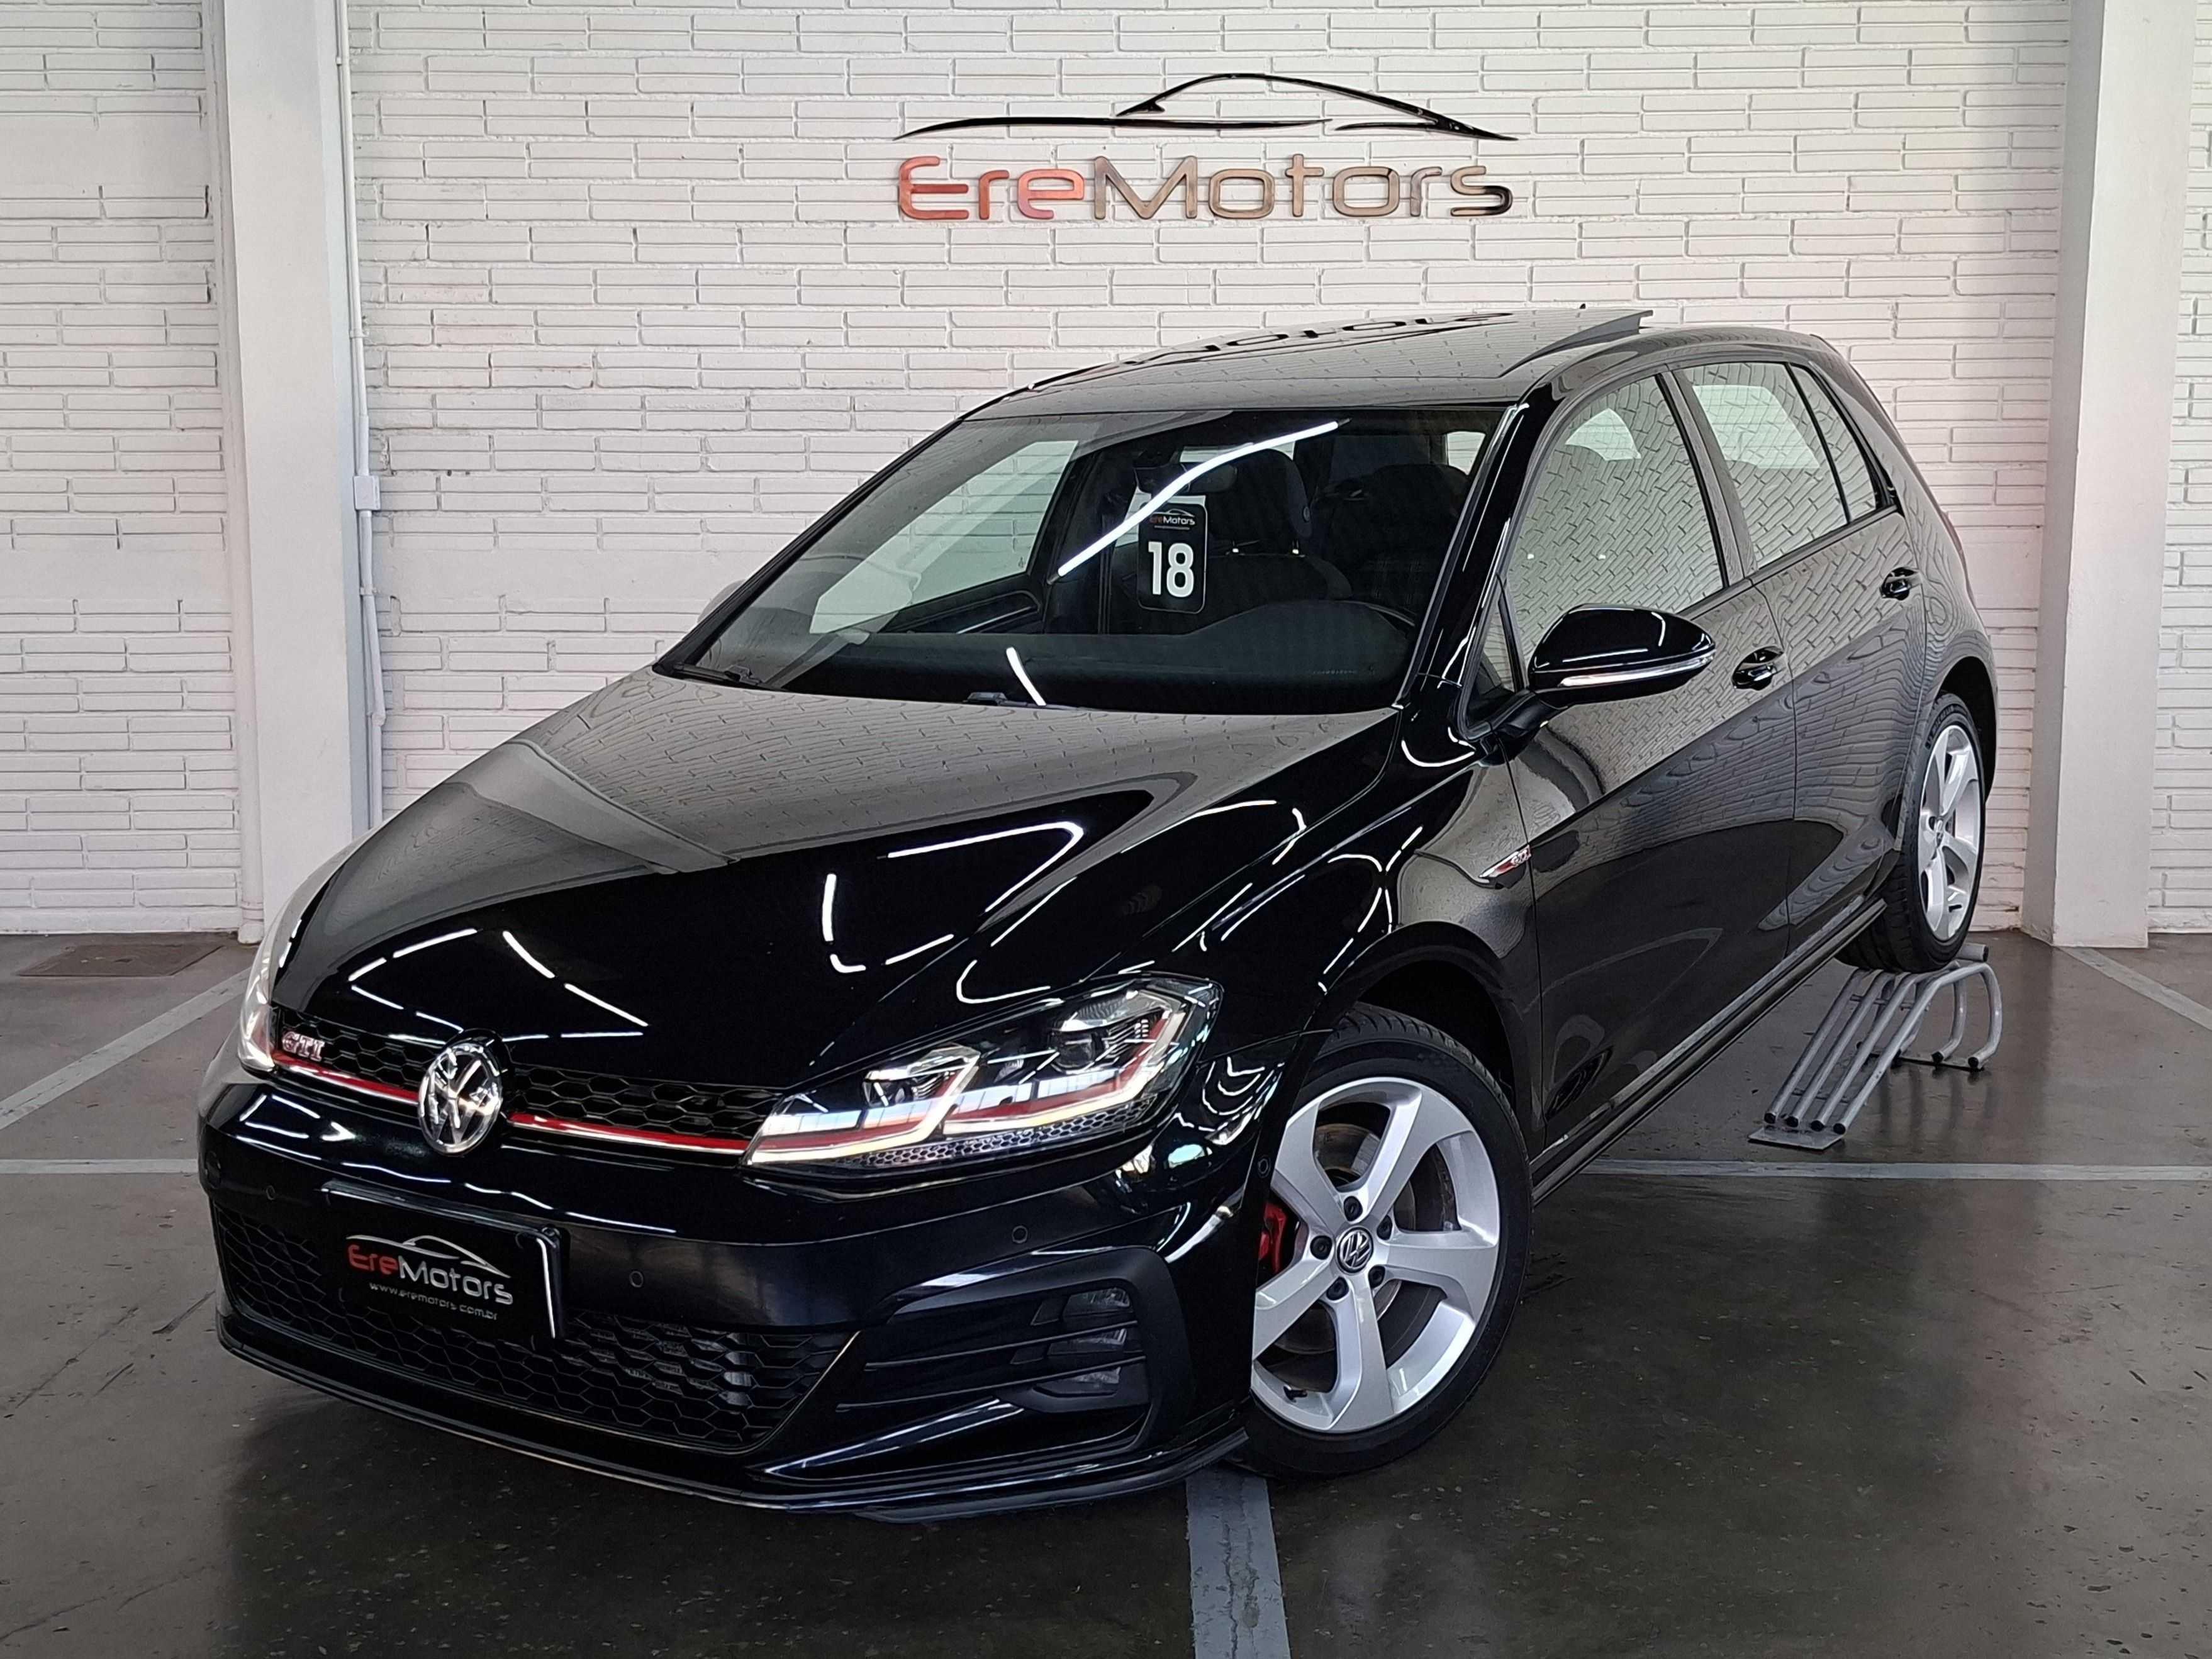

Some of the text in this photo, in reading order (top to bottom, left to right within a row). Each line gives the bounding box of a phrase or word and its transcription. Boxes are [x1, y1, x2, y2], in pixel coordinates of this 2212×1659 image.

[897, 154, 1512, 220] EreMotors
[1148, 540, 1194, 598] 18
[282, 1031, 325, 1062] GTI
[347, 1244, 513, 1305] EreMotors
